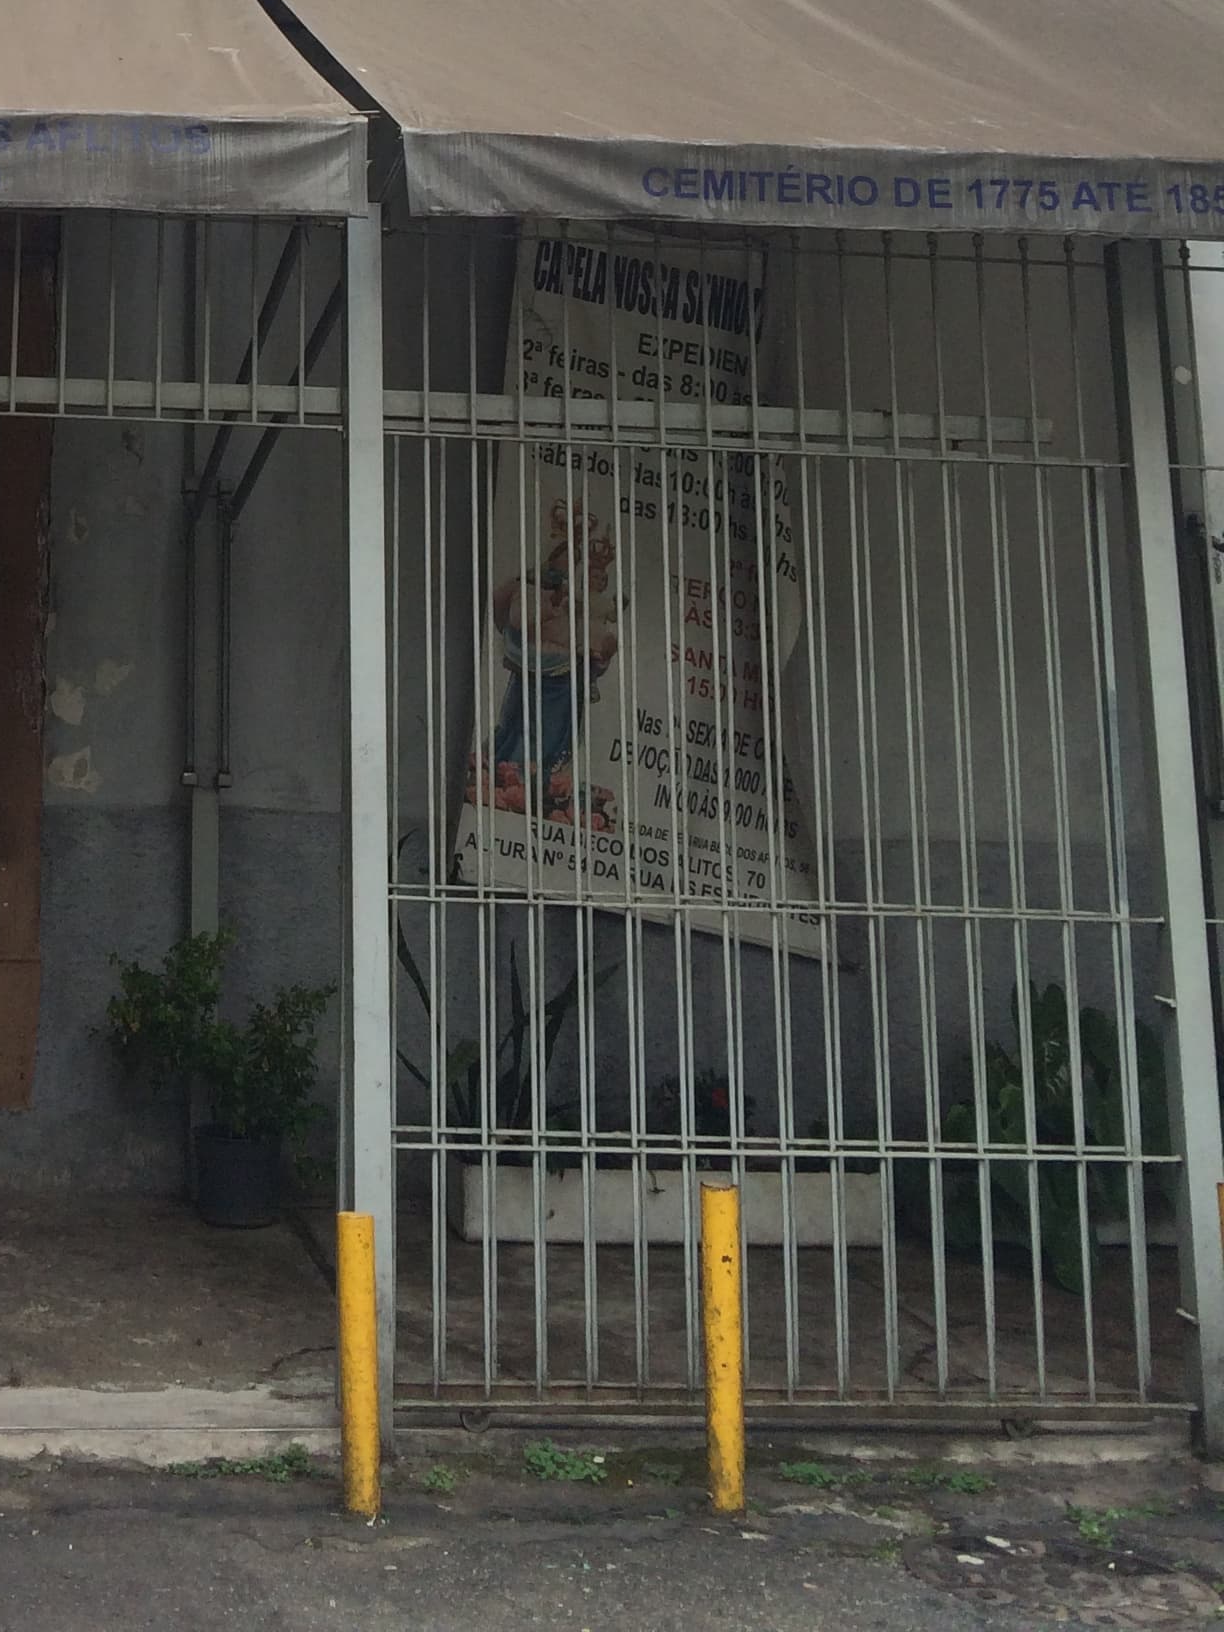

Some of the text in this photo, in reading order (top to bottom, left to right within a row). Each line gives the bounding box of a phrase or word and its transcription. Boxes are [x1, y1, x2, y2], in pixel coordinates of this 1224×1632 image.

[642, 164, 879, 207] CEMITÉRIO
[893, 176, 953, 209] DE
[967, 178, 1061, 211] 1775
[593, 858, 620, 881] DA
[746, 870, 766, 889] 70
